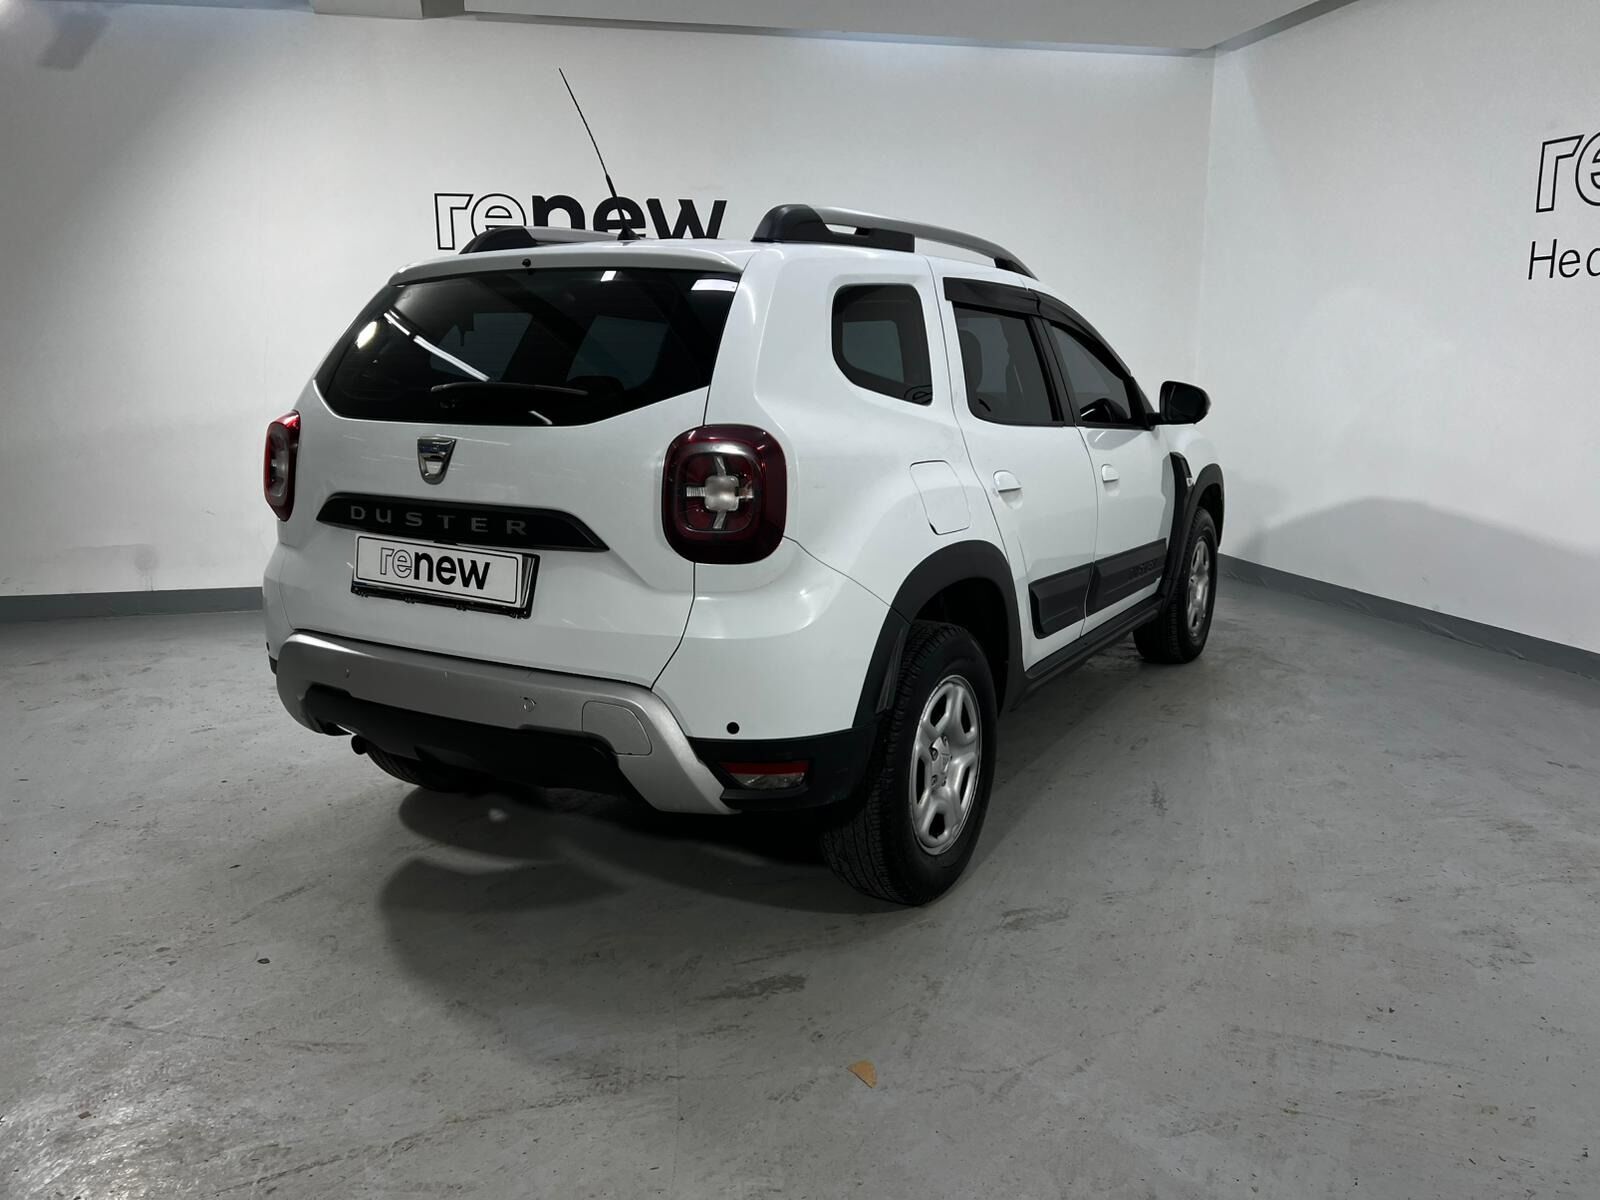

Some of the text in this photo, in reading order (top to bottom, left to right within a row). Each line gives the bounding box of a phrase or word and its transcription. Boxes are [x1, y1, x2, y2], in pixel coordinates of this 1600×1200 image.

[434, 193, 727, 250] renew
[350, 505, 527, 535] DUSTER
[379, 547, 490, 590] renew
